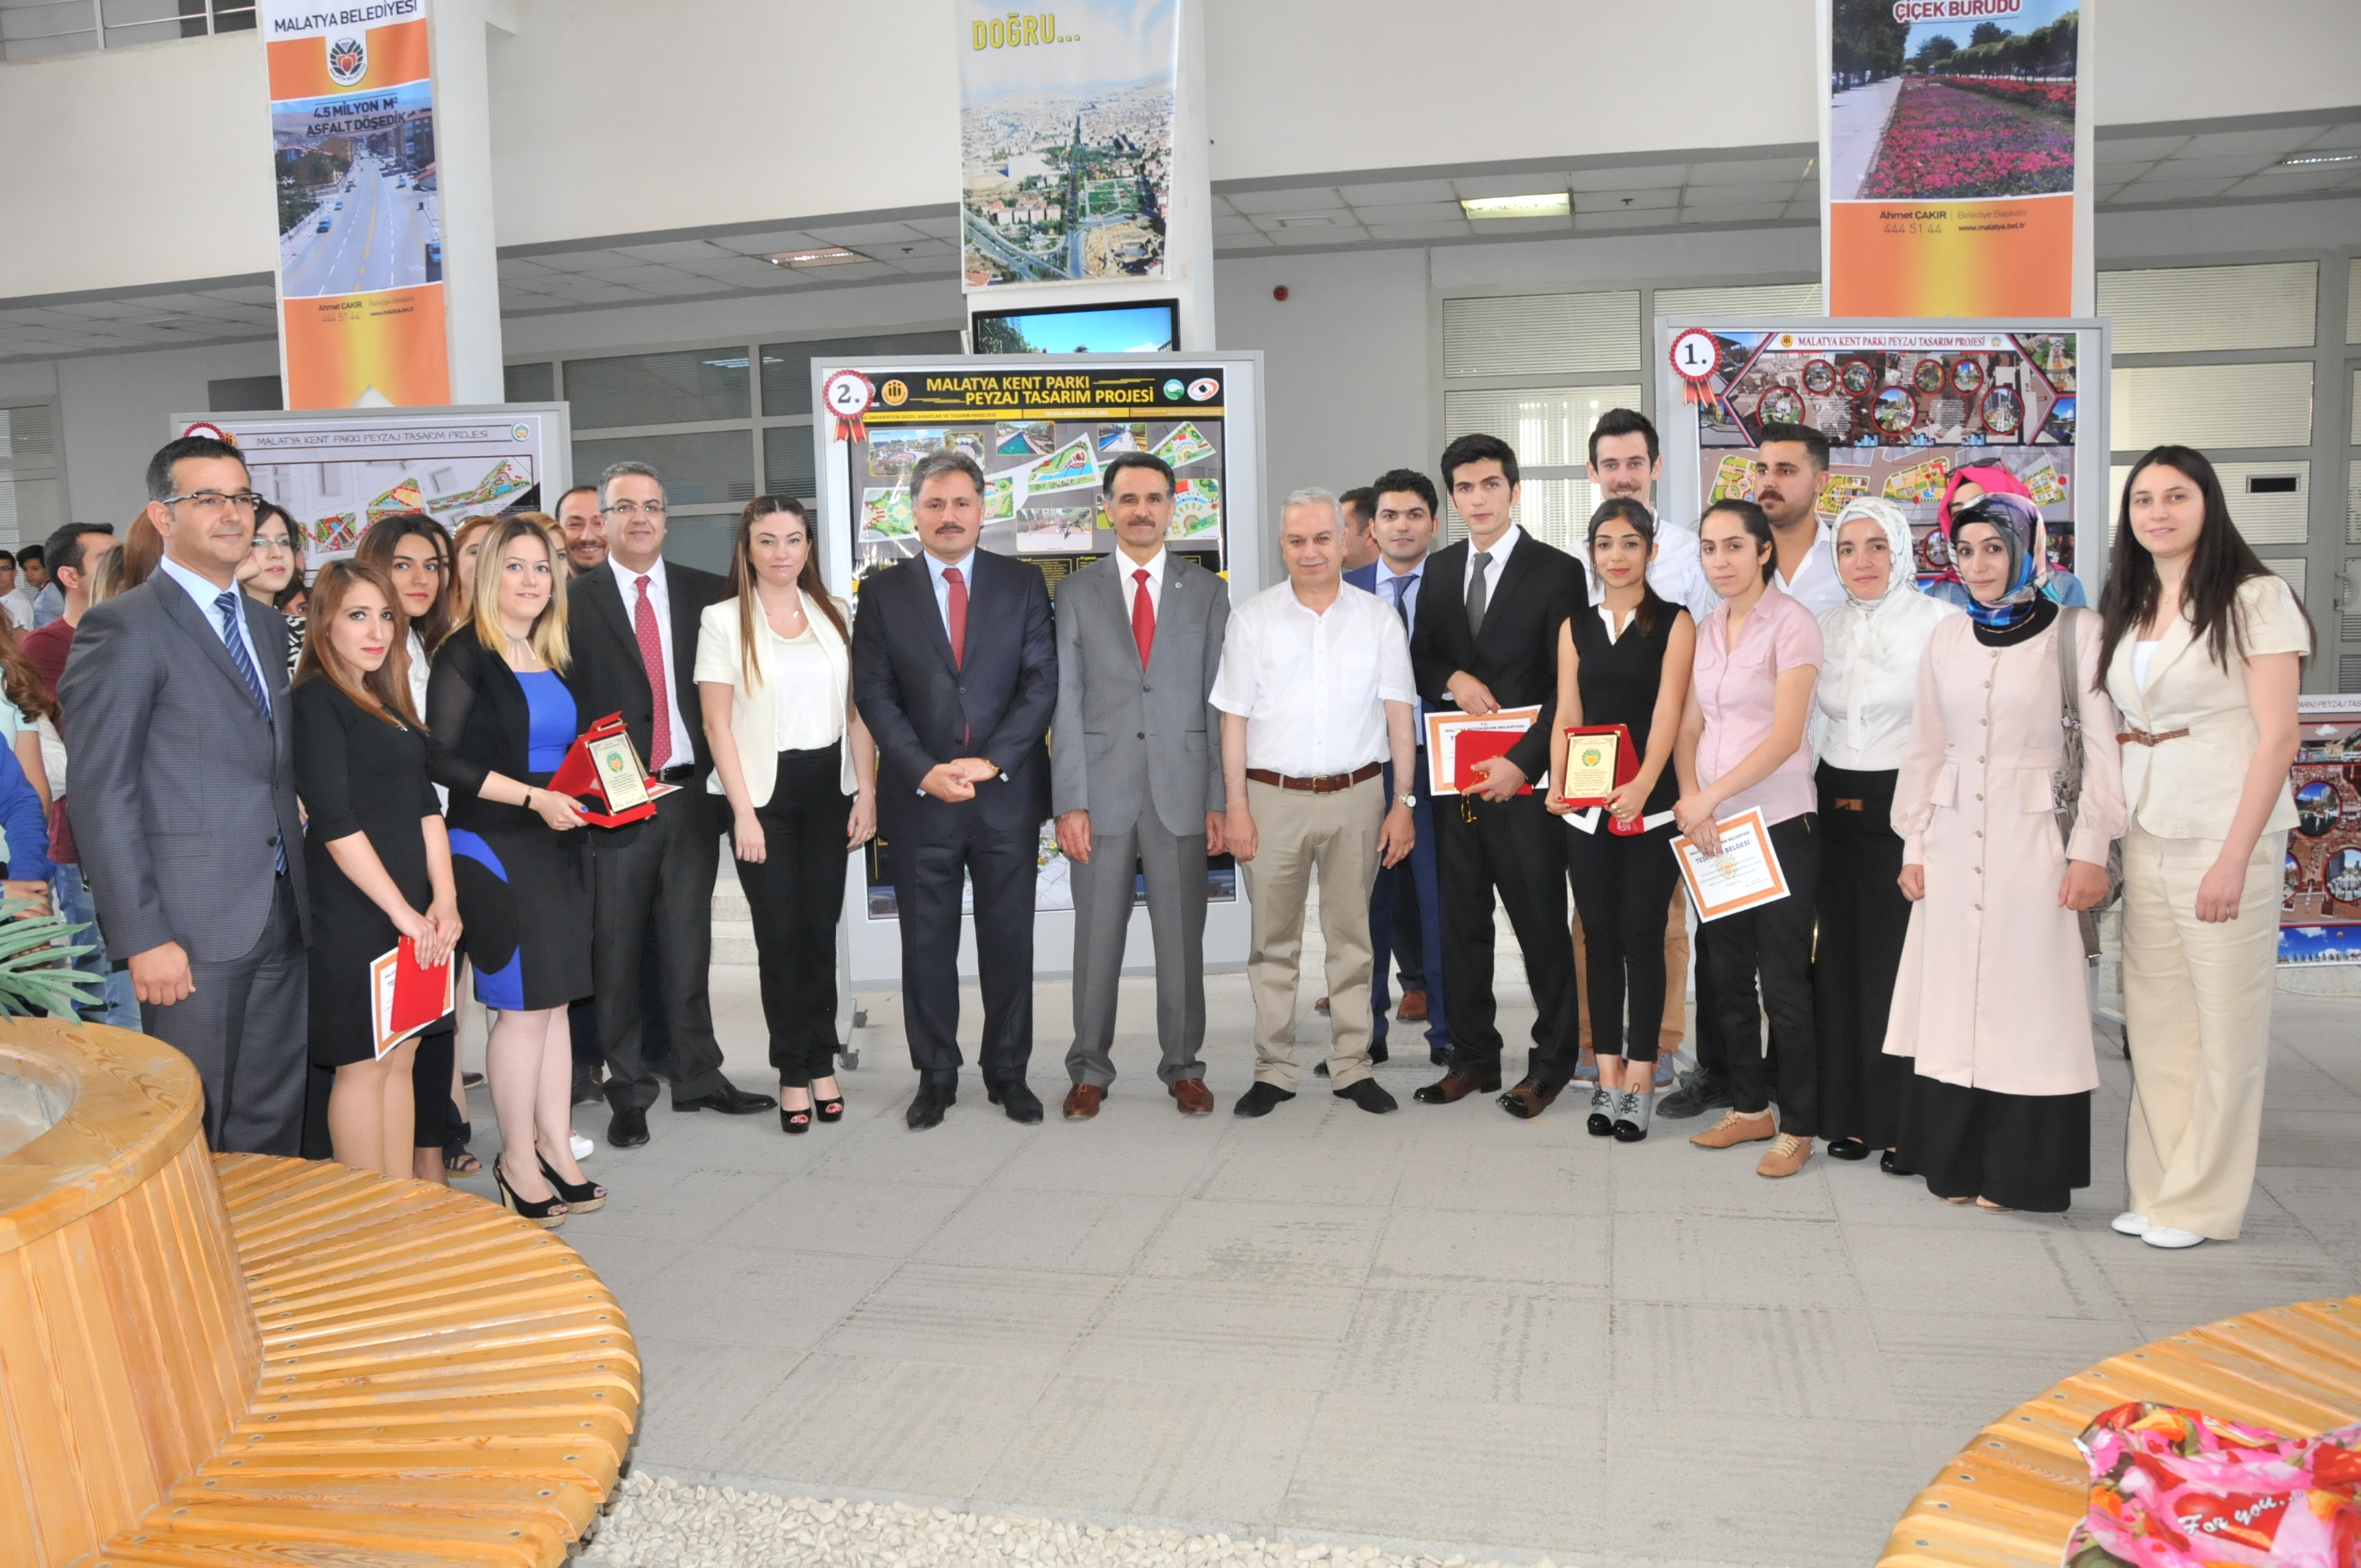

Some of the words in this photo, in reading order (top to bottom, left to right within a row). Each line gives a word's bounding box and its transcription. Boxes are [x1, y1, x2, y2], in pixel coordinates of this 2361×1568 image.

[275, 12, 338, 32] MALATYA
[972, 13, 1080, 50] DOĞRU...
[333, 101, 379, 117] MİLYON
[306, 120, 352, 137] ASFALT
[355, 111, 406, 130] DÖŞEDİK
[1879, 211, 1913, 219] Ahmet
[1915, 211, 1947, 220] ÇAKIR
[1958, 211, 1992, 220] Belediye
[1884, 223, 1905, 233] 444
[1910, 223, 1923, 233] 51
[1927, 223, 1942, 233] 44
[1958, 222, 2026, 232] www.malatya.bel.tr
[341, 301, 363, 310] ÇAKIR
[322, 313, 336, 322] 444
[338, 313, 347, 322] 51
[350, 312, 360, 320] 44
[1799, 336, 1836, 346] MALATYA
[1839, 337, 1861, 346] KENT
[1863, 337, 1887, 346] PARKI
[1888, 337, 1917, 346] PEYZAJ
[1919, 337, 1953, 346] TASARIM
[1955, 335, 1985, 346] PROJESİ
[1685, 343, 1707, 365] 1.
[926, 377, 995, 391] MALATYA
[1003, 377, 1042, 390] KENT
[1045, 376, 1089, 389] PARKI
[837, 383, 860, 404] 2.
[965, 391, 1018, 405] PEYZAJ
[1023, 390, 1091, 404] TASARIM
[1095, 386, 1154, 403] PROJESİ
[257, 436, 301, 446] MALATYA
[304, 435, 330, 444] KENT
[333, 434, 360, 443] PARKI
[364, 433, 401, 443] PEYZAJ
[404, 431, 445, 440] TASARIM
[448, 429, 487, 440] PROJESİ
[1724, 839, 1750, 854] BELGESİ
[2177, 1514, 2229, 1536] For
